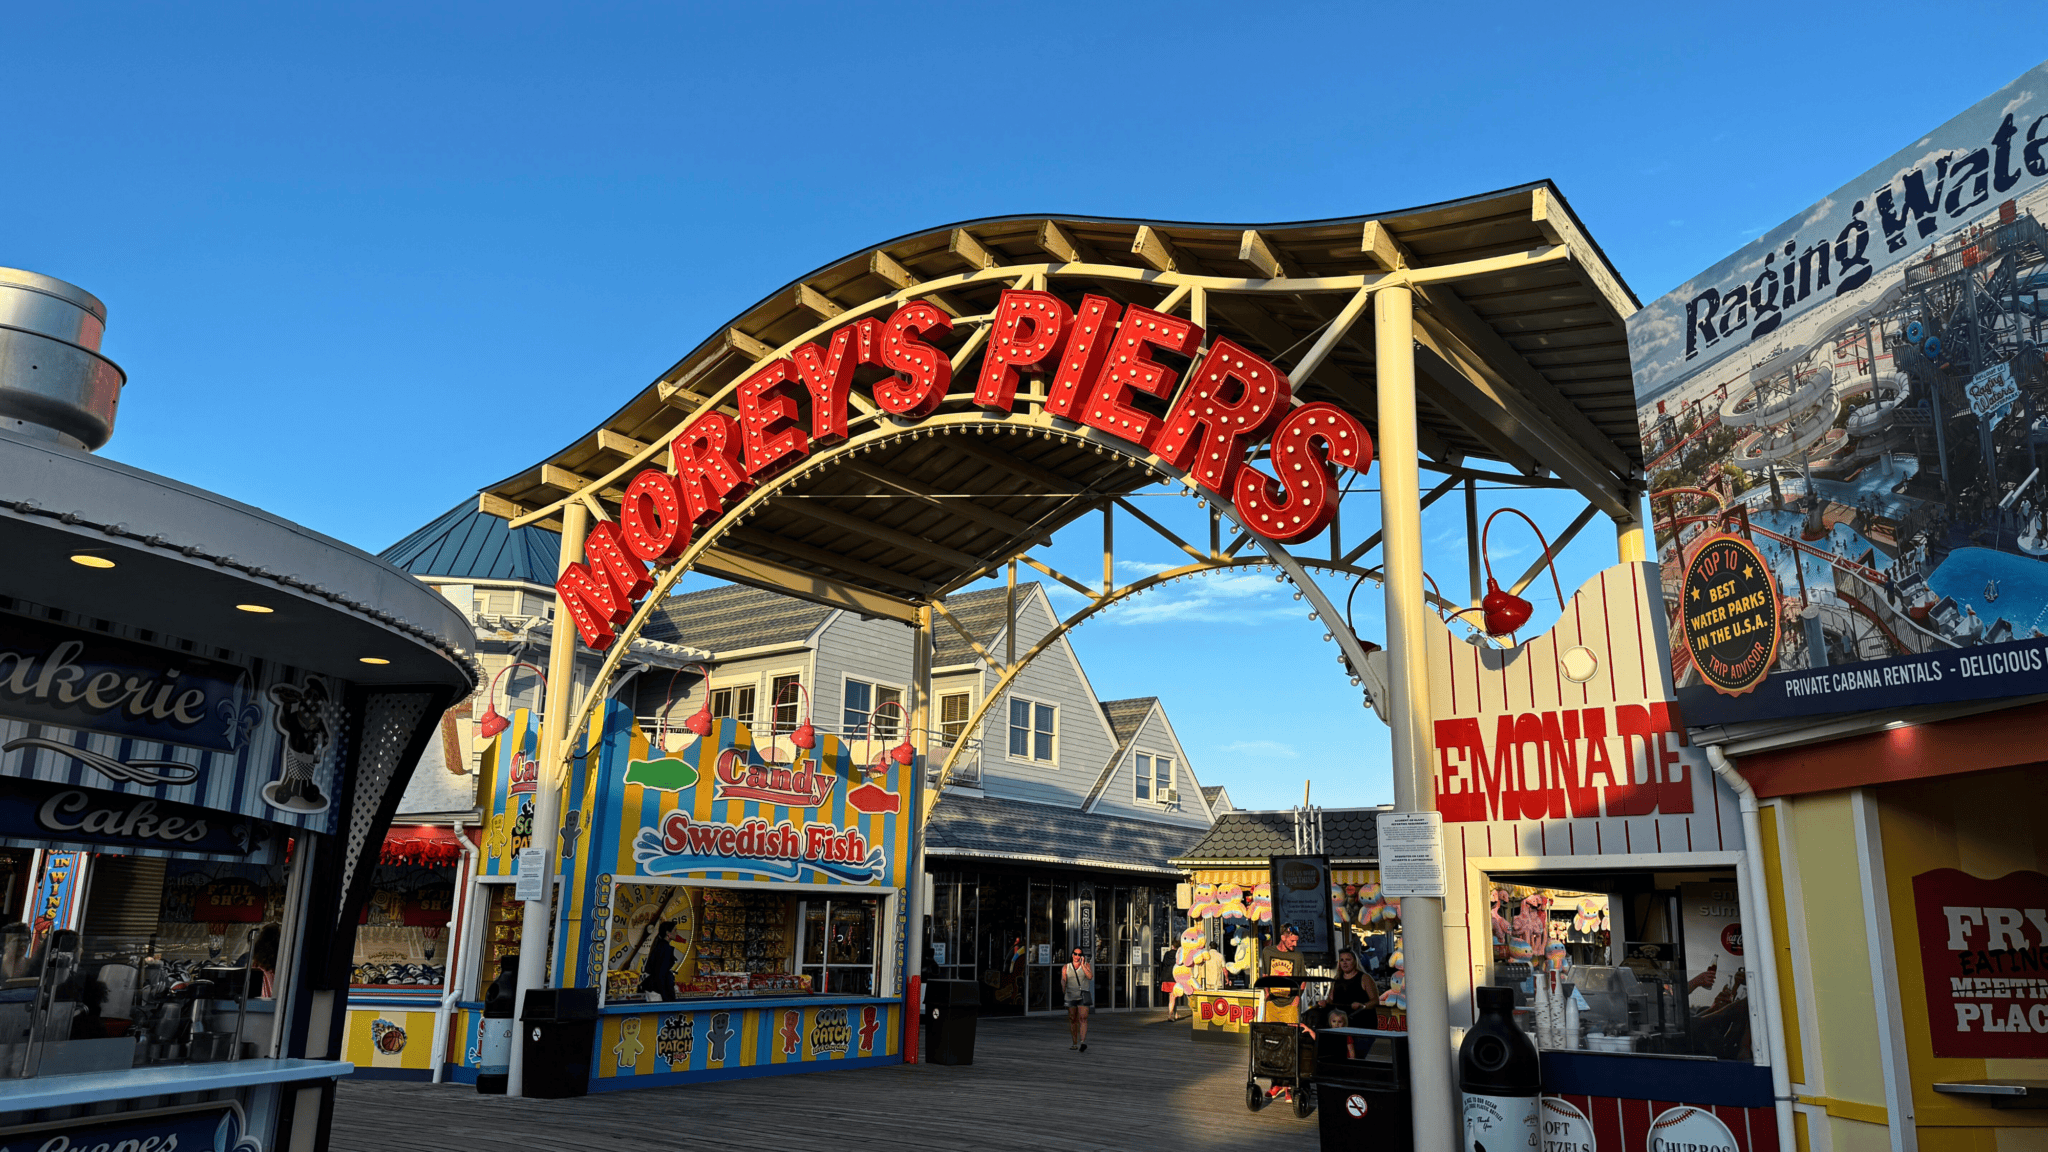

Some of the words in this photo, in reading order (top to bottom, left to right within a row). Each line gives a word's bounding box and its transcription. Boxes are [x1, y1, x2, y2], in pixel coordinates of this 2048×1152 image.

[1686, 200, 1873, 361] Raging
[1969, 374, 2004, 400] Raging
[556, 300, 954, 651] MOREY'S
[974, 289, 1373, 544] PIERS
[1697, 551, 1720, 582] TOP
[1724, 549, 1738, 571] 10
[1709, 579, 1736, 603] BEST
[1690, 606, 1727, 632] WATER
[1728, 590, 1766, 618] PARKS
[1697, 635, 1710, 651] IN
[1710, 626, 1731, 646] THE
[1732, 613, 1768, 638] U.S.A.
[1709, 654, 1728, 678] TRIP
[1731, 641, 1765, 679] ADVISOR
[1785, 675, 1831, 697] PRIVATE
[1832, 669, 1882, 692] CABANA
[1884, 660, 1943, 687] RENTALS
[1960, 648, 2042, 678] DELICIOUS
[717, 749, 836, 807] Candy
[1434, 701, 1694, 823] EMONADE
[39, 791, 208, 842] Cakes
[663, 815, 800, 860] Swedish
[804, 826, 866, 864] Fish
[54, 857, 71, 867] IN
[46, 871, 68, 919] WINS
[601, 875, 611, 904] ONE
[597, 908, 610, 938] WIN
[899, 915, 907, 938] WIN
[1943, 906, 2048, 952] FRY
[591, 943, 605, 988] CHOI
[660, 1027, 692, 1040] SOUR
[817, 1010, 847, 1028] SOUR
[658, 1040, 692, 1055] PATCH
[812, 1026, 851, 1046] PATCH
[1485, 1100, 1497, 1109] OCEAN
[1489, 1108, 1503, 1122] BOTTLES
[1543, 1121, 1570, 1136] OFT
